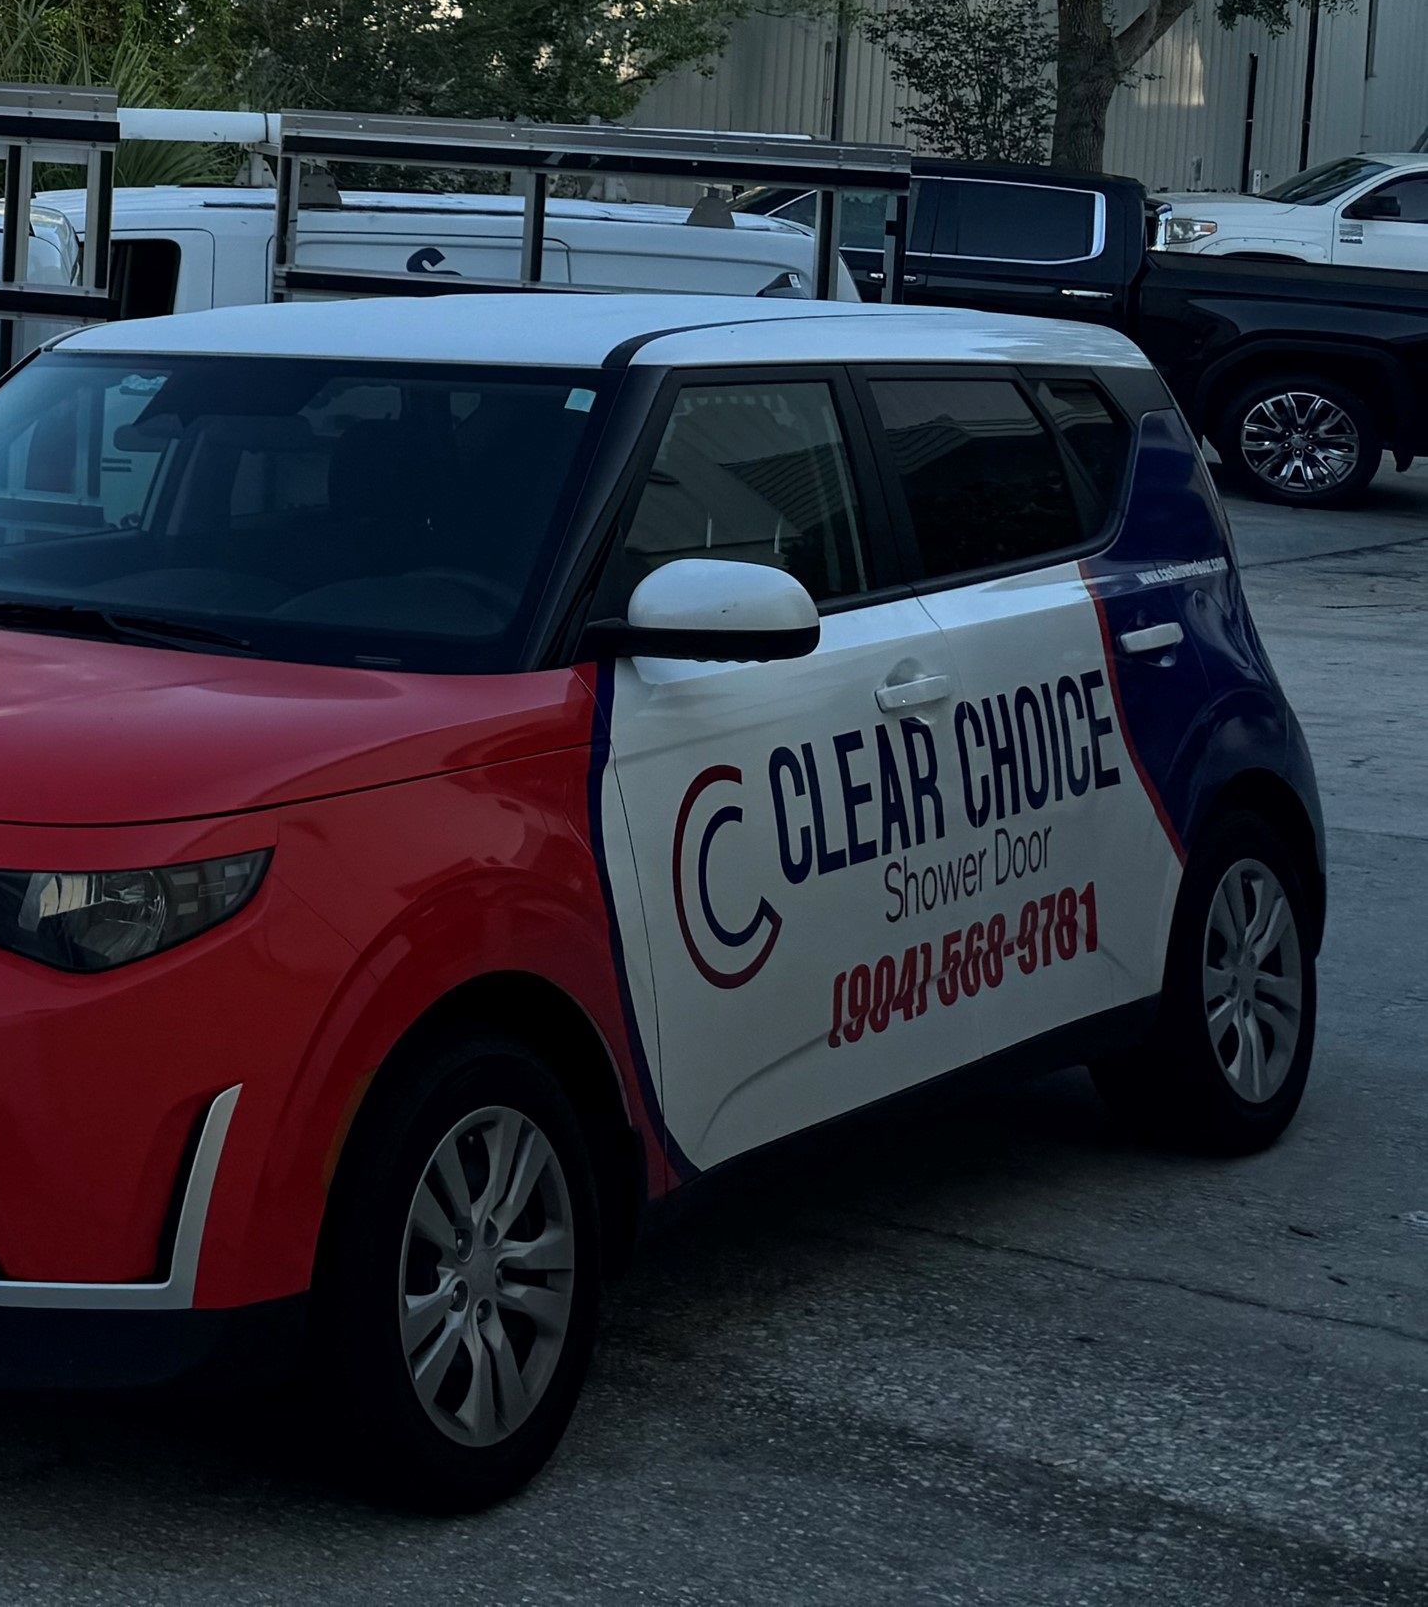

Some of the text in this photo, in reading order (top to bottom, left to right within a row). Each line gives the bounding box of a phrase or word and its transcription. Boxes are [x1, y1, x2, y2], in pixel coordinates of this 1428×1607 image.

[767, 669, 1122, 885] CLEAR CHOICE
[884, 825, 1052, 924] Shower Door
[935, 881, 1100, 1008] 568-9781
